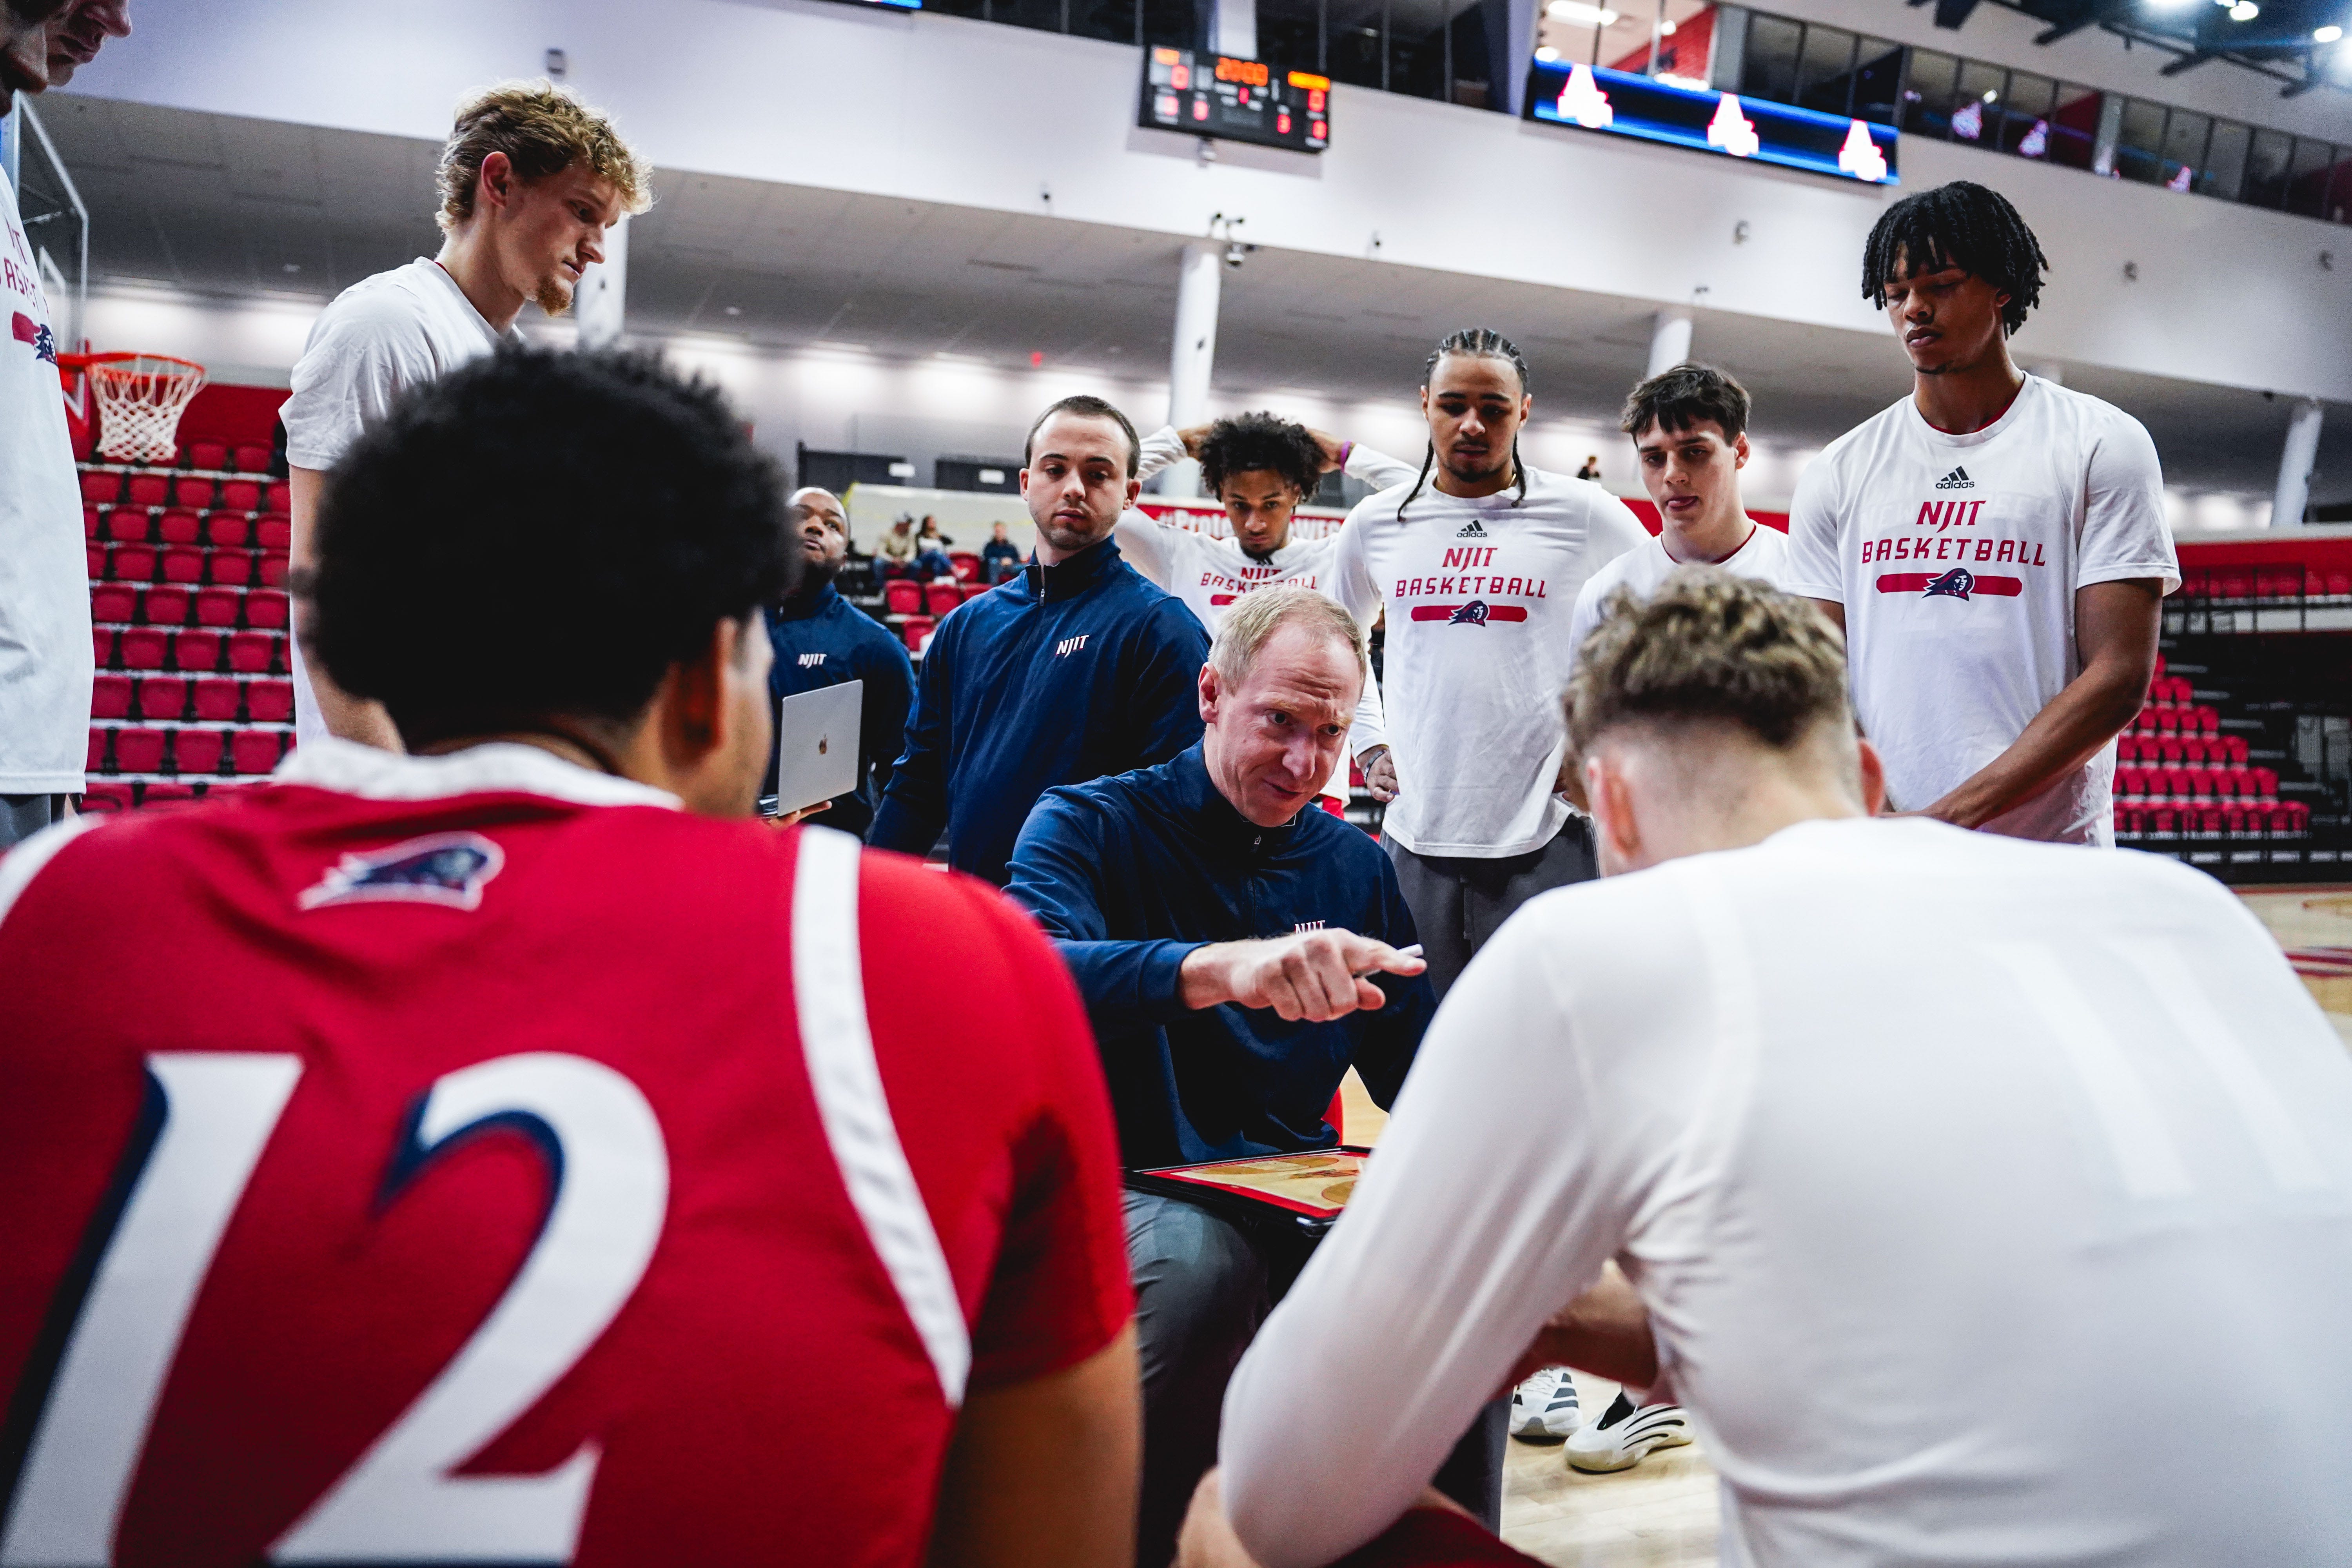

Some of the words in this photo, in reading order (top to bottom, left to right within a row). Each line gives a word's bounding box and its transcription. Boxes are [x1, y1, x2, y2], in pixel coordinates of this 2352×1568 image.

[1935, 480, 1975, 489] adidas
[1916, 500, 1987, 533] NJIT
[1442, 547, 1498, 573] NJIT
[1862, 537, 2046, 566] BASKETBALL
[1396, 576, 1546, 598] BASKETBALL
[1055, 635, 1090, 658] NJIT
[797, 653, 828, 669] NJIT
[0, 1051, 668, 1568] 12
